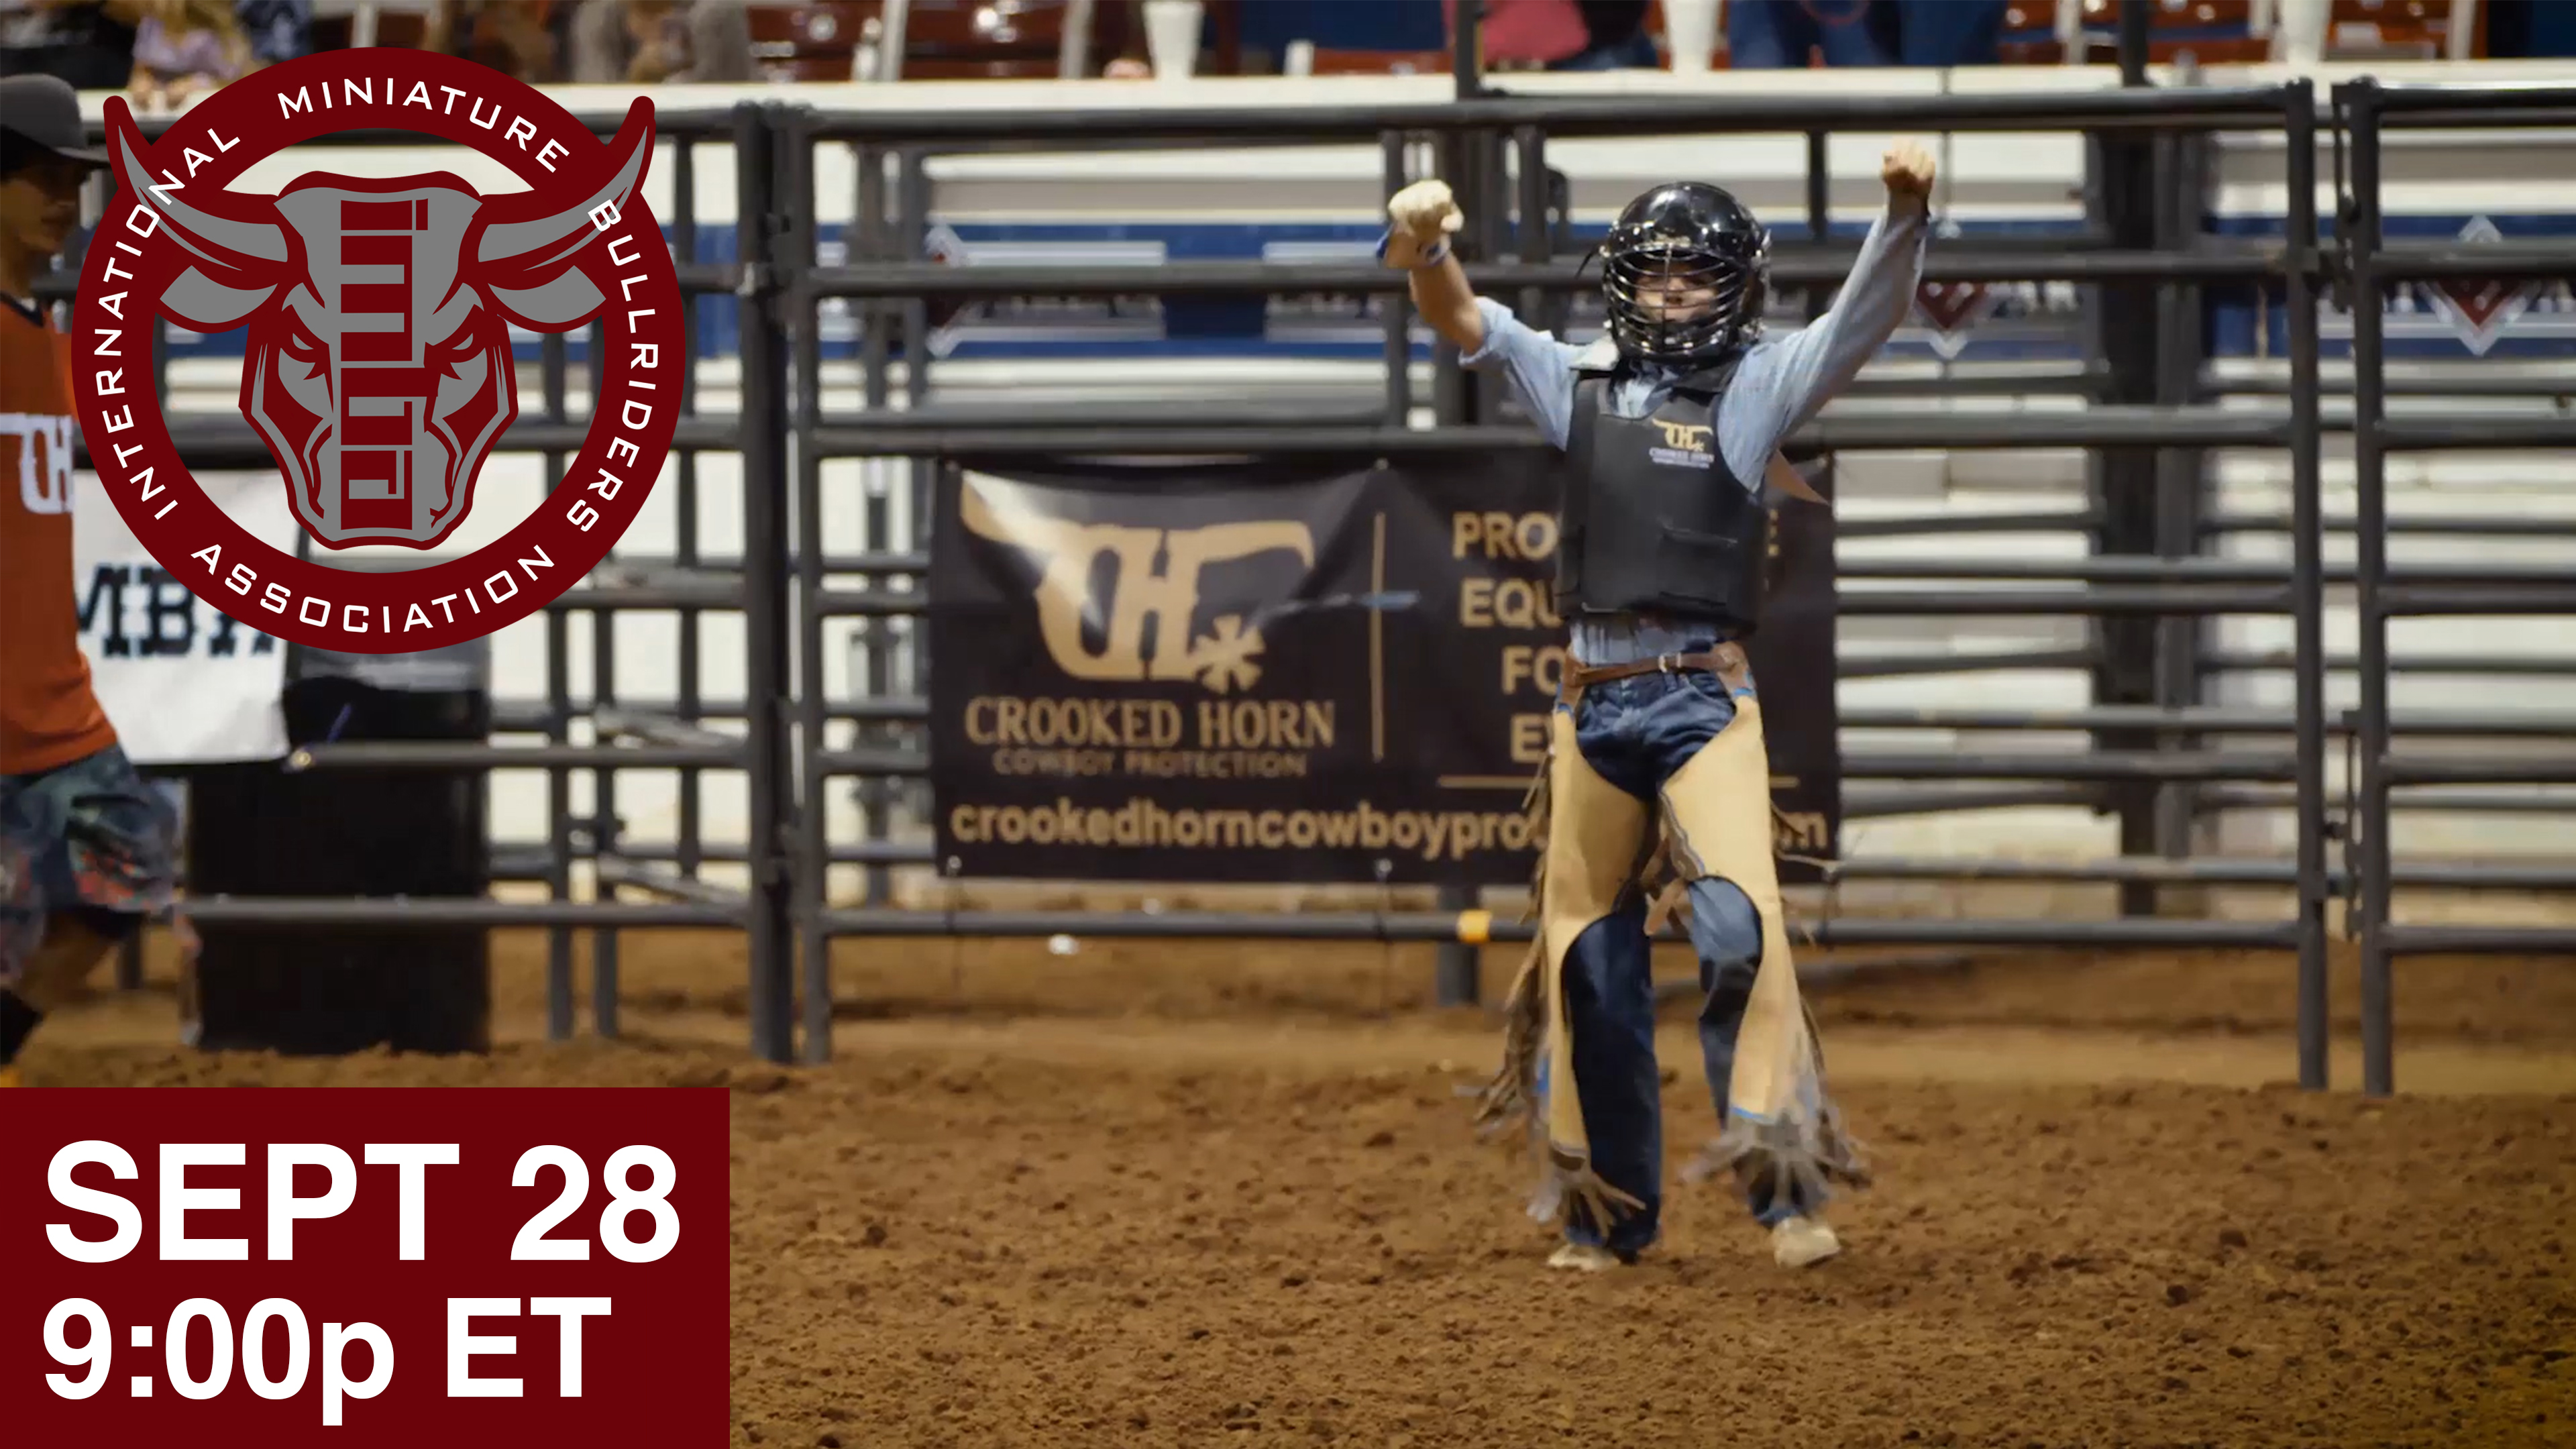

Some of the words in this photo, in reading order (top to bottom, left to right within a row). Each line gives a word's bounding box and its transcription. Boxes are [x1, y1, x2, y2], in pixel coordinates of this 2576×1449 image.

[1501, 645, 1566, 696] FO
[965, 696, 1183, 747] CROOKED
[1198, 700, 1335, 747] HORN
[992, 748, 1115, 775] COWBOY
[1125, 750, 1307, 777] PROTECTION
